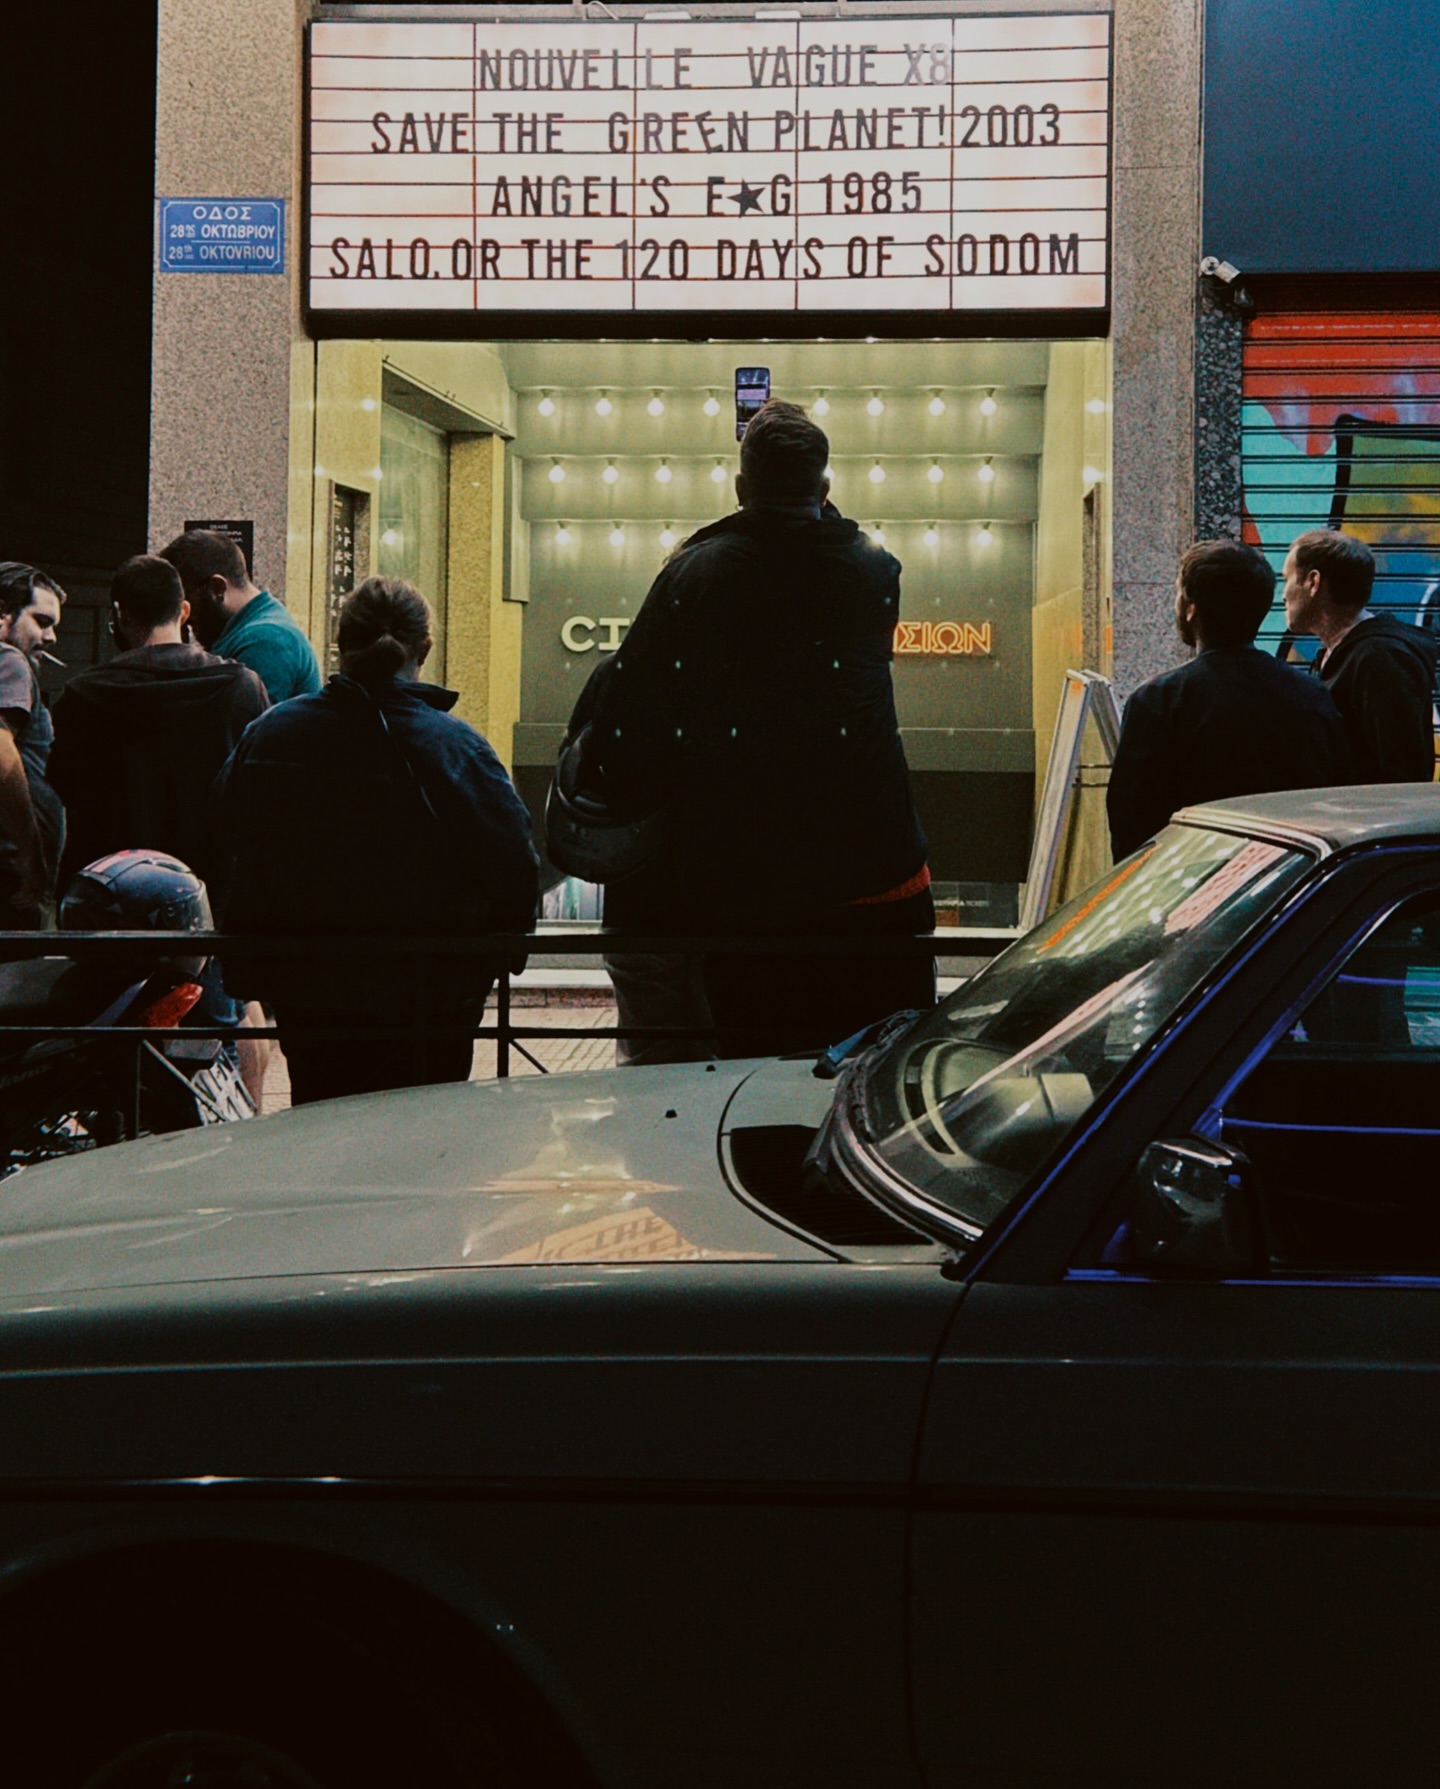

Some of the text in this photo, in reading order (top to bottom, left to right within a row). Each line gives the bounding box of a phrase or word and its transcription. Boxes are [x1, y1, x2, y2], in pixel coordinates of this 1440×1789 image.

[480, 42, 951, 91] NOUVELLE VAGUE X8
[371, 111, 469, 154] SAVE
[492, 112, 564, 154] THE
[608, 110, 749, 154] GREEN
[960, 103, 1061, 148] 2003
[193, 206, 252, 220] ΟΔΟΣ
[491, 174, 671, 217] ANGEL'S
[818, 171, 922, 215] 1985
[199, 245, 275, 260] OKTOVRIOU
[201, 224, 275, 239] ΟΚΤΩΒΡΙΟΥ
[521, 239, 593, 280] THE
[614, 238, 690, 280] 120
[717, 237, 825, 280] DAYS
[847, 235, 894, 278] OF
[924, 232, 1079, 277] SODOM
